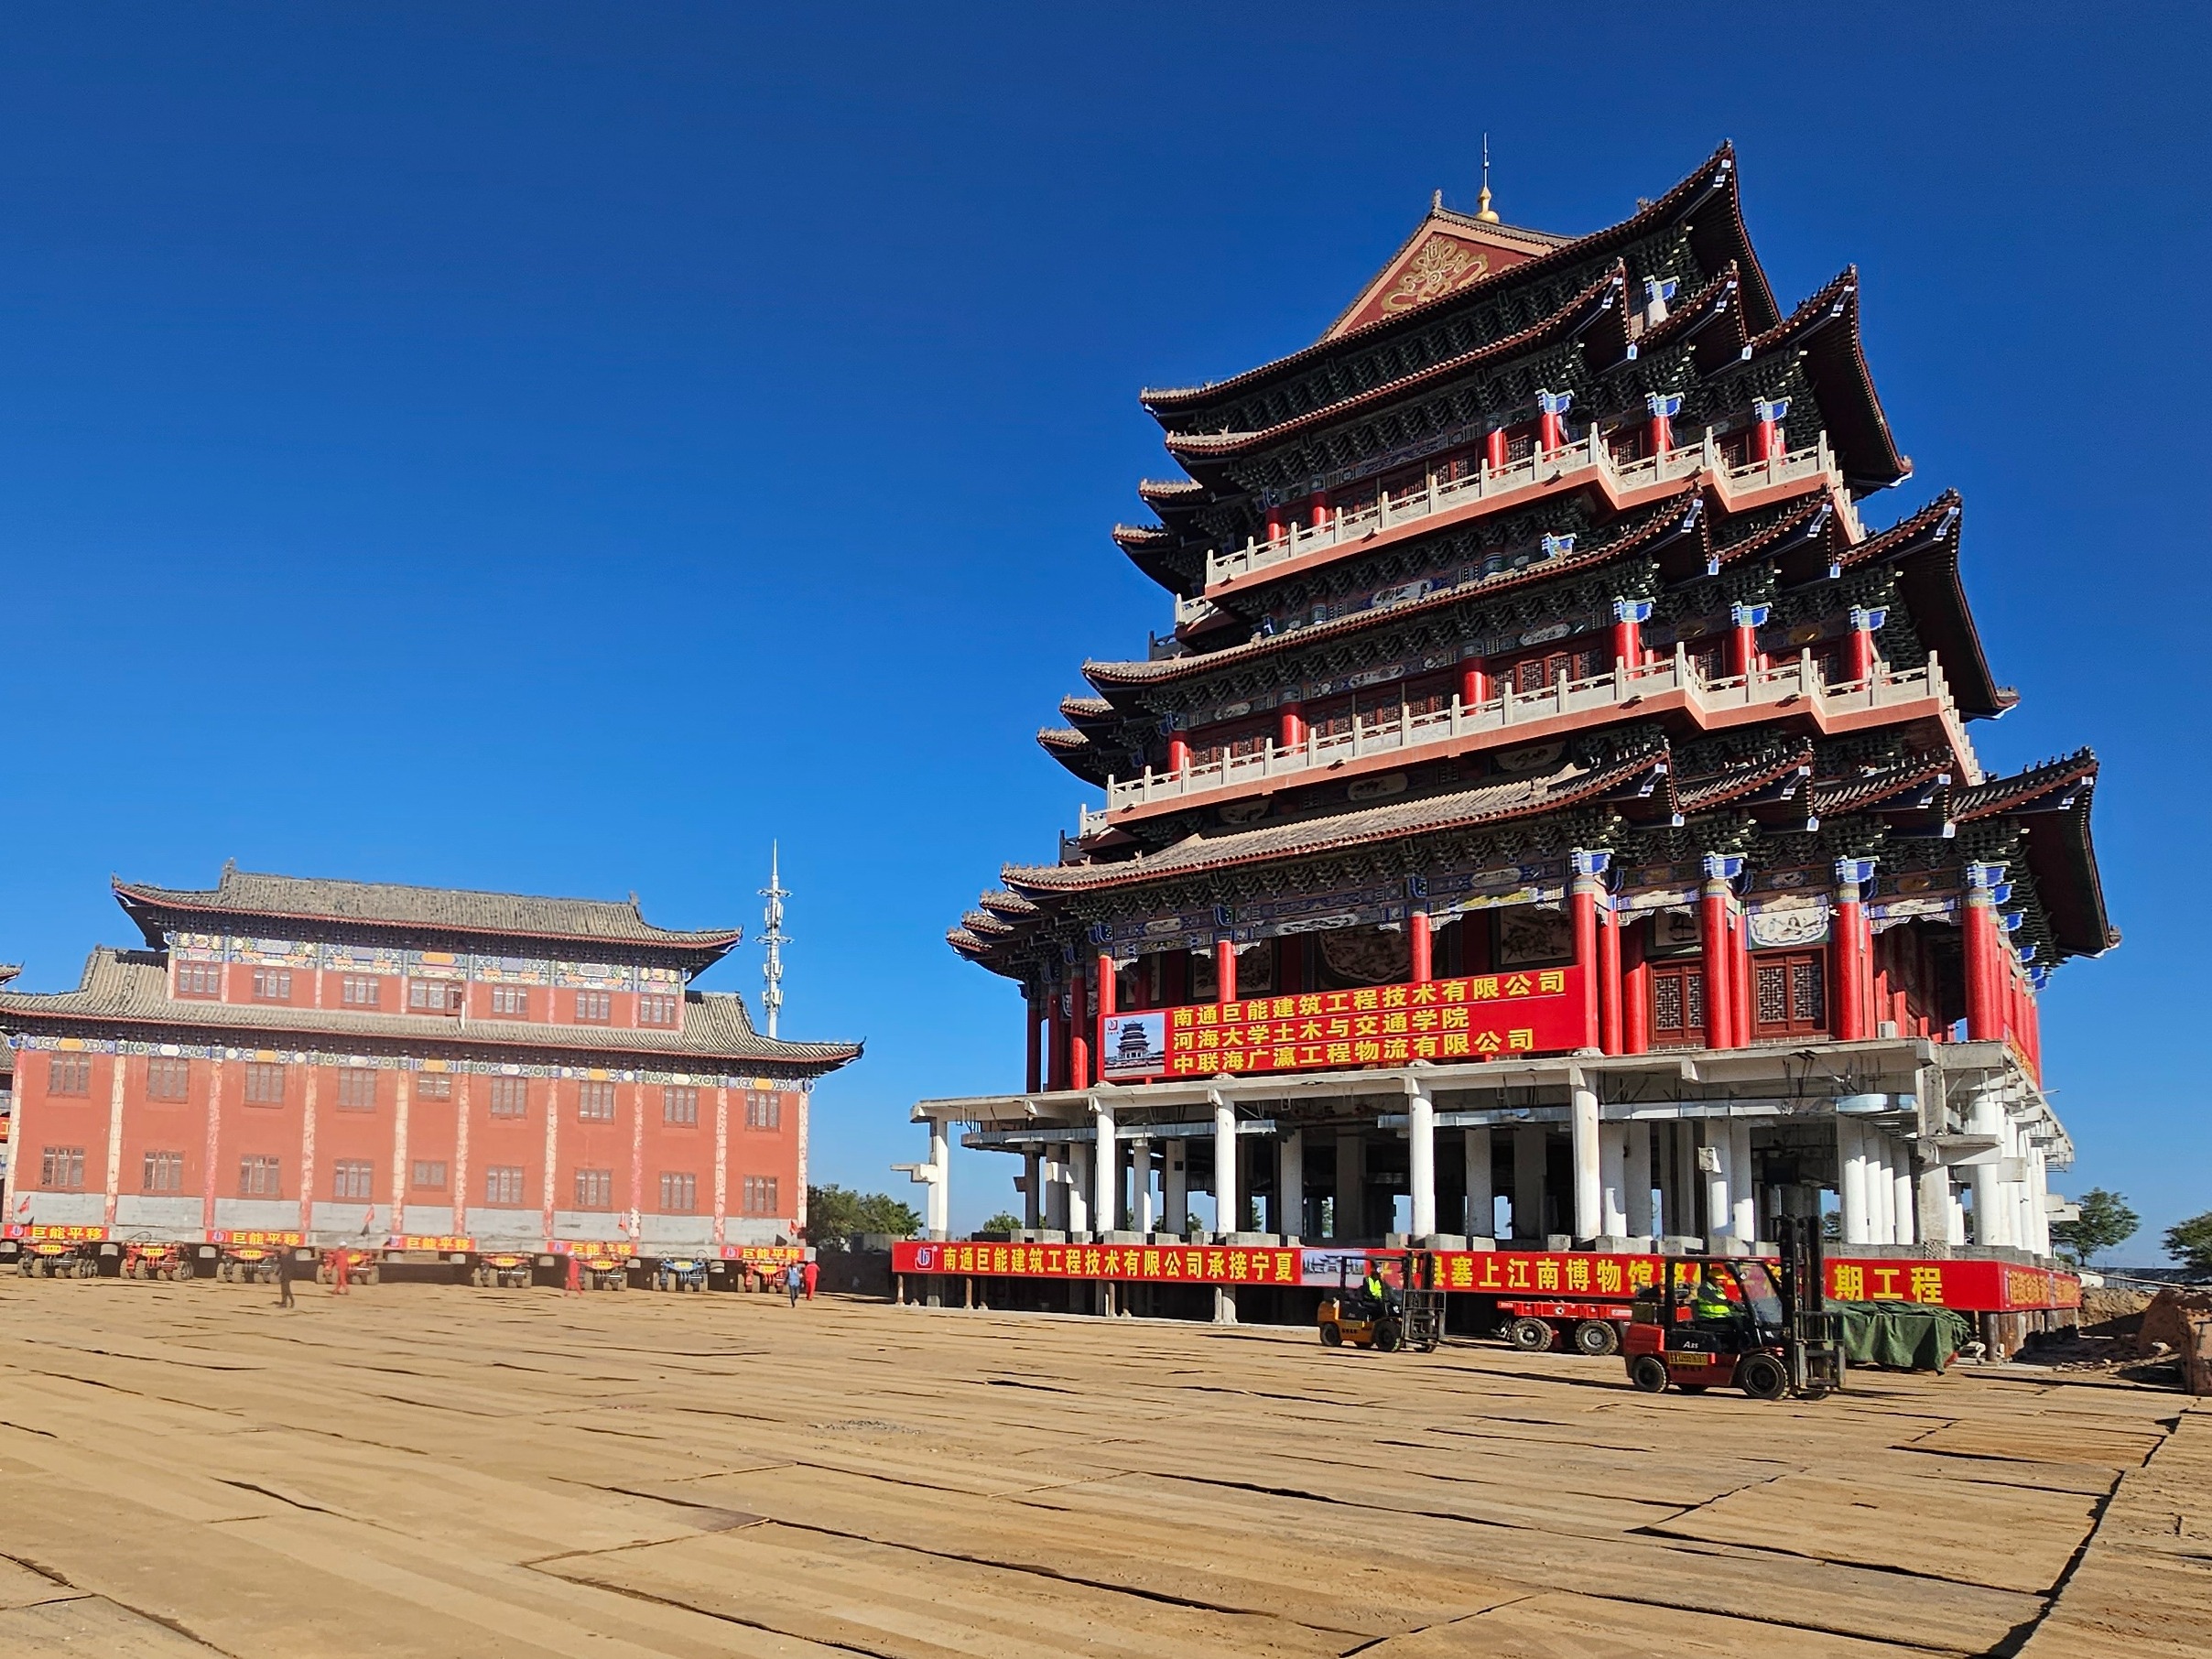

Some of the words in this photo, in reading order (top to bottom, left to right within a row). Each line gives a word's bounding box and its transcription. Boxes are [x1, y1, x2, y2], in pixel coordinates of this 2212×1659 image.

[1174, 970, 1565, 1027] 南通巨能建筑工程技术有限公司
[1174, 1006, 1469, 1050] 河海大学土木与交通学院
[32, 1226, 103, 1240] 巨能平移
[232, 1231, 299, 1245] 巨能平移
[407, 1236, 470, 1251] 巨能平移
[743, 1247, 799, 1261] 巨能平移
[943, 1246, 1294, 1282] 南通巨能建筑工程技术有限公司承接宁夏
